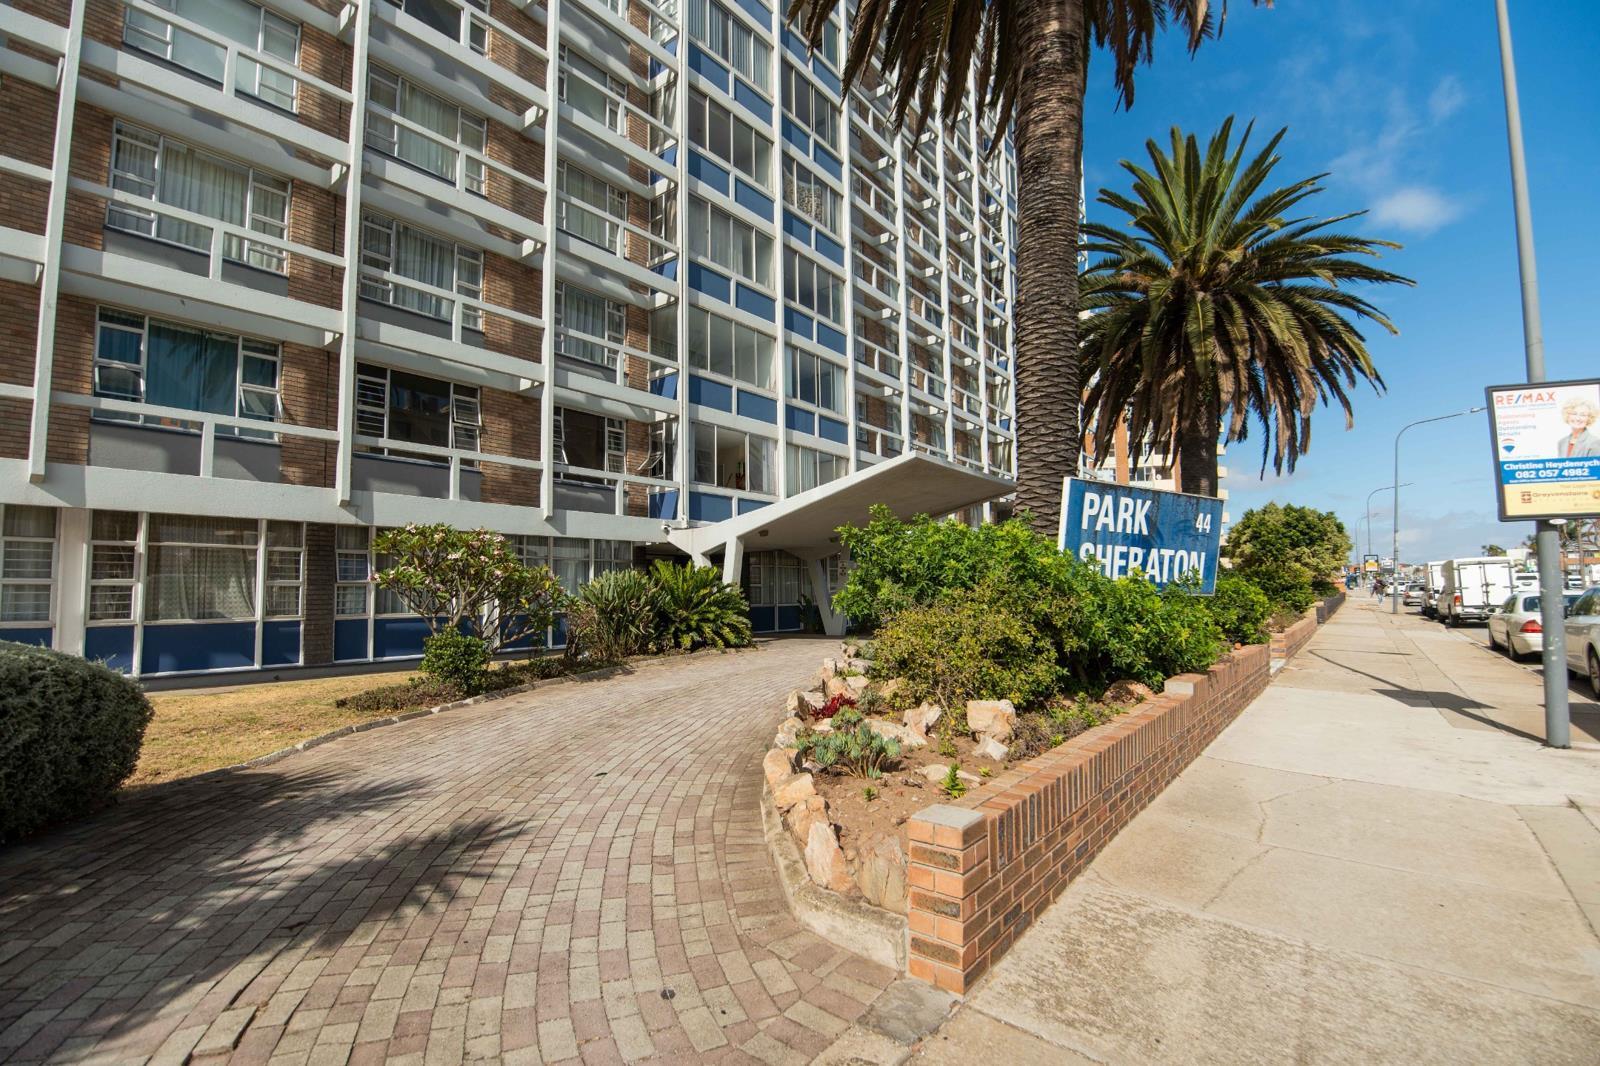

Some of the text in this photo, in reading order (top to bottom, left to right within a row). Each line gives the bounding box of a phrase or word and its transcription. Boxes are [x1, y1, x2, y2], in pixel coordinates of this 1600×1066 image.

[1495, 392, 1556, 405] RE/MAX
[1504, 462, 1543, 470] Christine
[1515, 468, 1590, 479] 082 057 4982
[1081, 491, 1152, 536] PARK
[1195, 512, 1212, 534] 44
